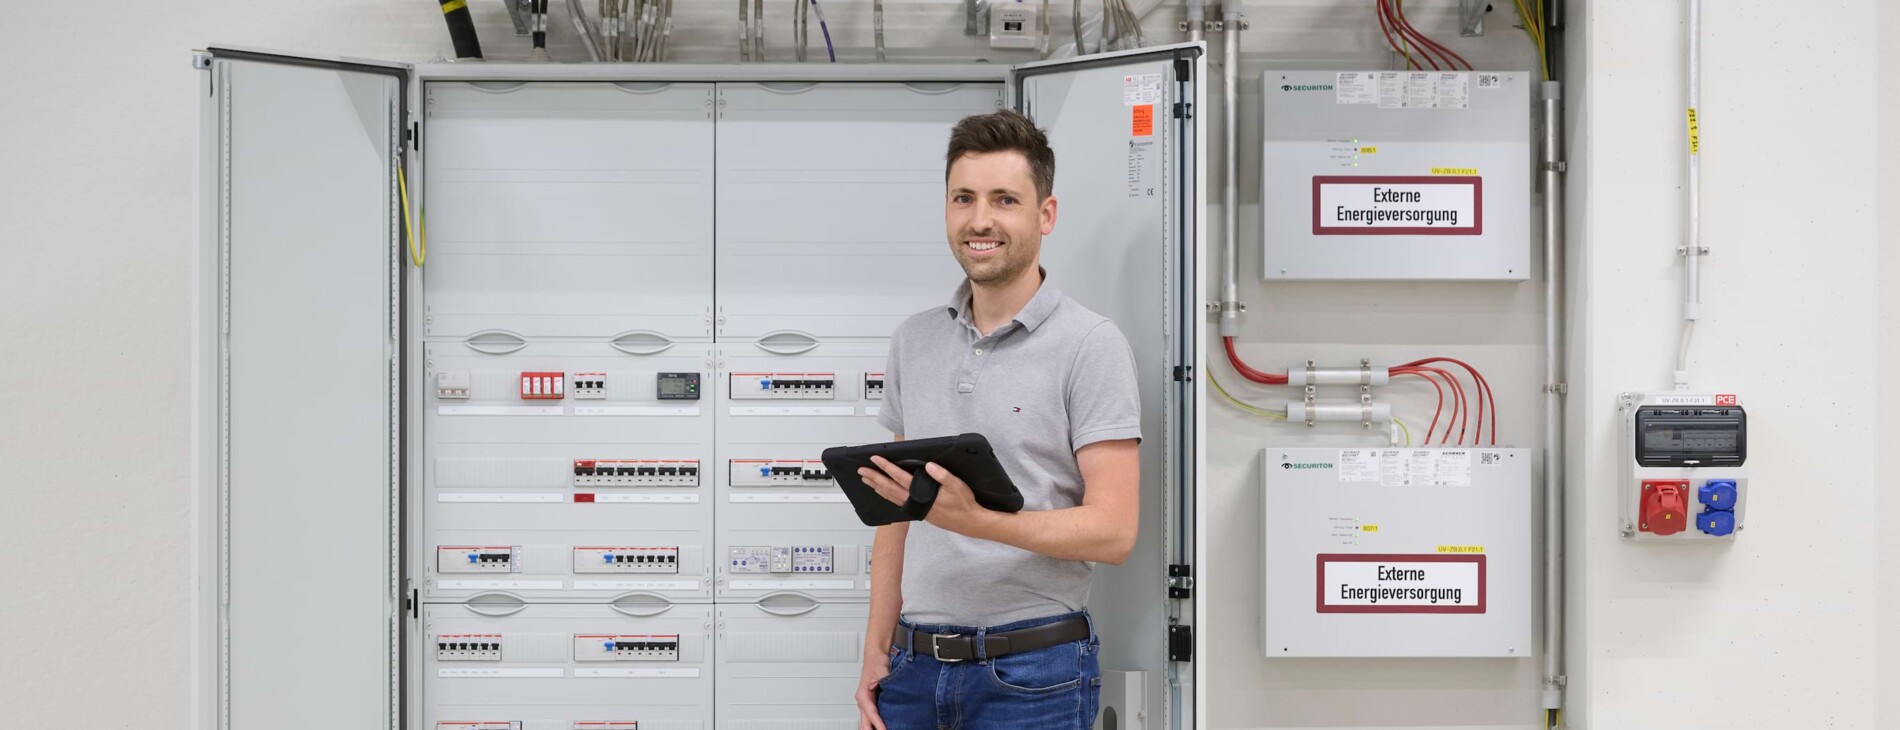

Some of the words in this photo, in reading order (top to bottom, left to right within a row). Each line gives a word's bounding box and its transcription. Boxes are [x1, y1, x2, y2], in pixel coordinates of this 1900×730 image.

[1374, 187, 1421, 203] Externe
[1337, 206, 1458, 226] Energieversorgung
[1717, 395, 1735, 404] PCE
[1378, 565, 1425, 581] Externe
[1341, 584, 1462, 604] Energieversorgung
